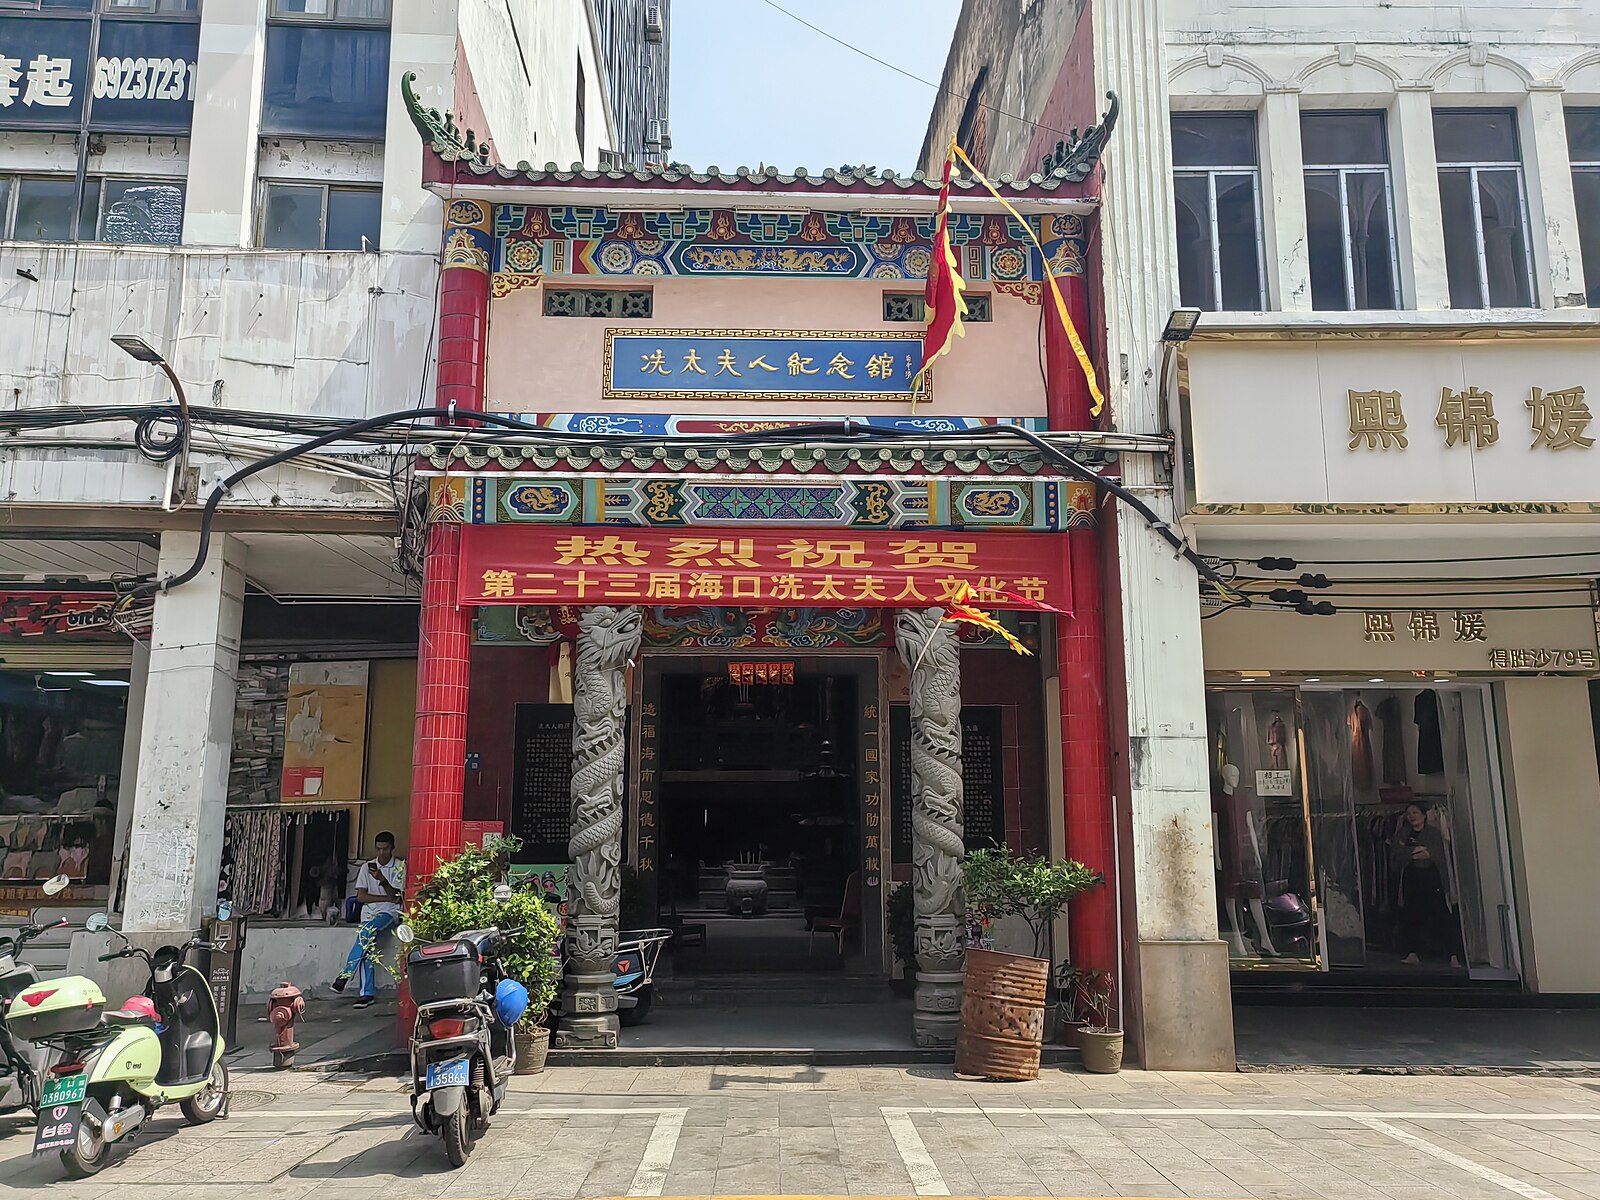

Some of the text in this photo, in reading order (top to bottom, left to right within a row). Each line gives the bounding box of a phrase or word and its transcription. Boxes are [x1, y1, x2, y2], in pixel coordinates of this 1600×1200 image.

[93, 56, 197, 102] 69237231
[1346, 385, 1597, 451] 熙锦媛
[553, 535, 980, 570] 热烈祝贺
[481, 568, 1048, 604] 第二十三届海口冼太夫人文化节
[1363, 610, 1489, 643] 熙锦媛
[1487, 648, 1597, 669] 得胜沙79号
[42, 1087, 84, 1105] 0380967
